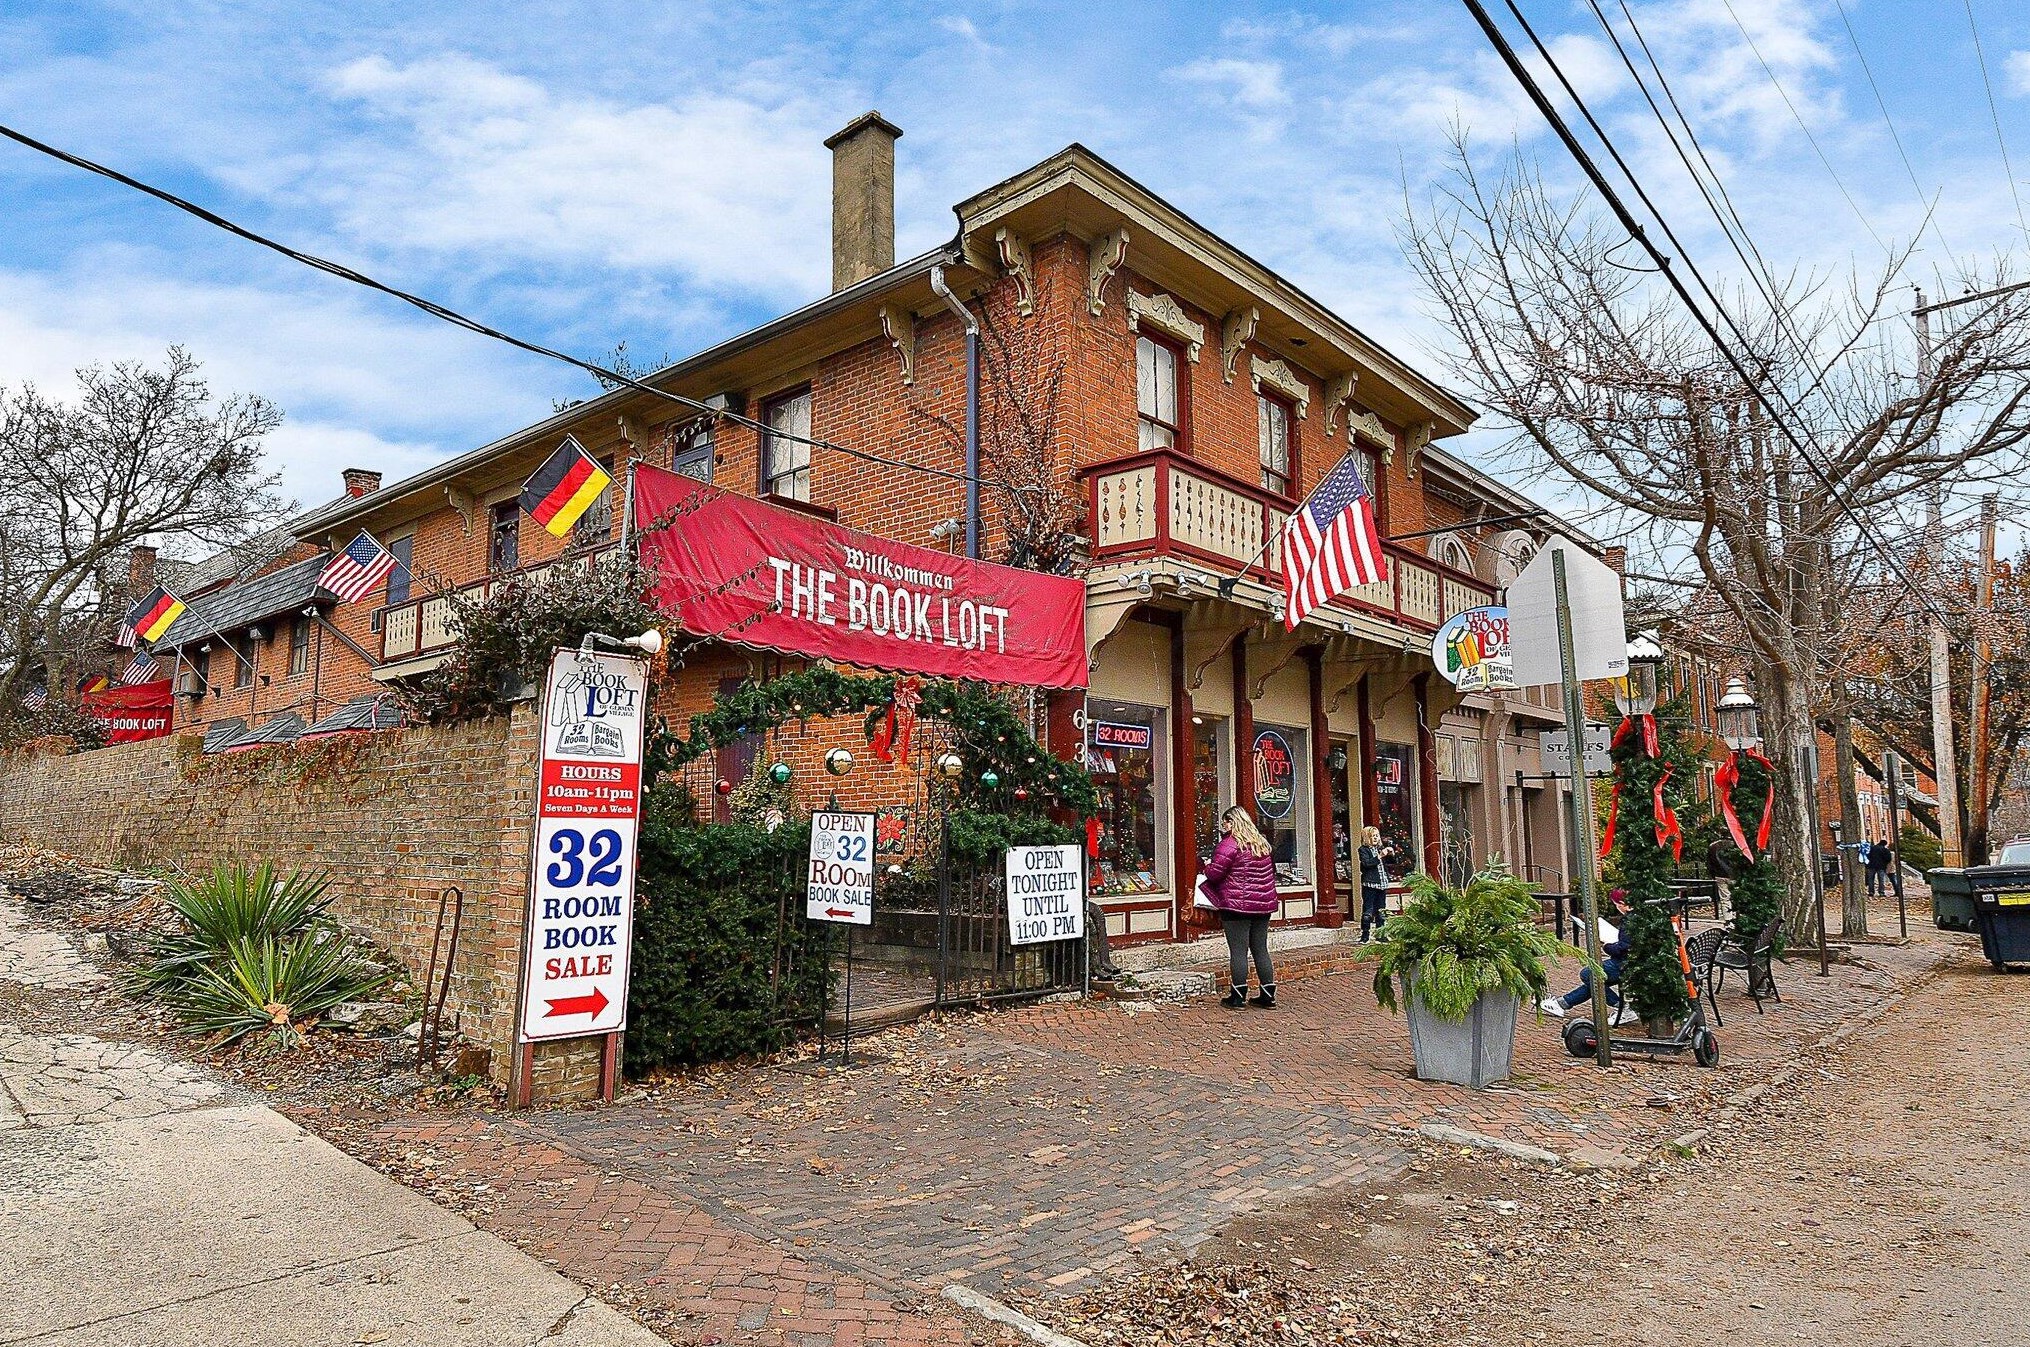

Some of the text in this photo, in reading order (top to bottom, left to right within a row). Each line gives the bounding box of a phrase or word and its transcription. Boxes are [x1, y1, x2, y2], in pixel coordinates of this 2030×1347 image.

[844, 546, 953, 590] Willkommen
[767, 556, 1009, 654] THE BOOK LOFT
[1463, 610, 1489, 622] THE
[1466, 667, 1479, 679] 32
[1488, 665, 1513, 676] Bargain
[1489, 674, 1513, 683] Books
[582, 672, 628, 689] BOOK
[1461, 675, 1484, 686] Rooms
[583, 685, 639, 718] LOFT
[113, 718, 140, 730] BOOK
[142, 718, 167, 730] LOFT
[569, 723, 586, 736] 32
[594, 724, 620, 740] Bargain
[564, 735, 589, 745] Rooms
[594, 735, 619, 749] Books
[1098, 726, 1147, 744] 32 ROOMS
[1260, 740, 1274, 749] THE
[1264, 749, 1285, 760] BOOK
[560, 765, 622, 780] HOURS
[546, 785, 634, 802] 10am-11pm
[545, 803, 633, 814] Seven Days A Week
[818, 814, 867, 832] OPEN
[836, 835, 867, 862] 32
[546, 828, 622, 888] 32
[1025, 850, 1064, 870] OPEN
[810, 859, 871, 888] ROOM
[1012, 872, 1078, 894] TONIGHT
[809, 886, 871, 906] BOOK SALE
[542, 895, 622, 919] ROOM
[1022, 895, 1069, 917] UNTIL
[1016, 915, 1076, 940] 11:00 PM
[543, 925, 617, 949] BOOK
[544, 954, 613, 980] SALE
